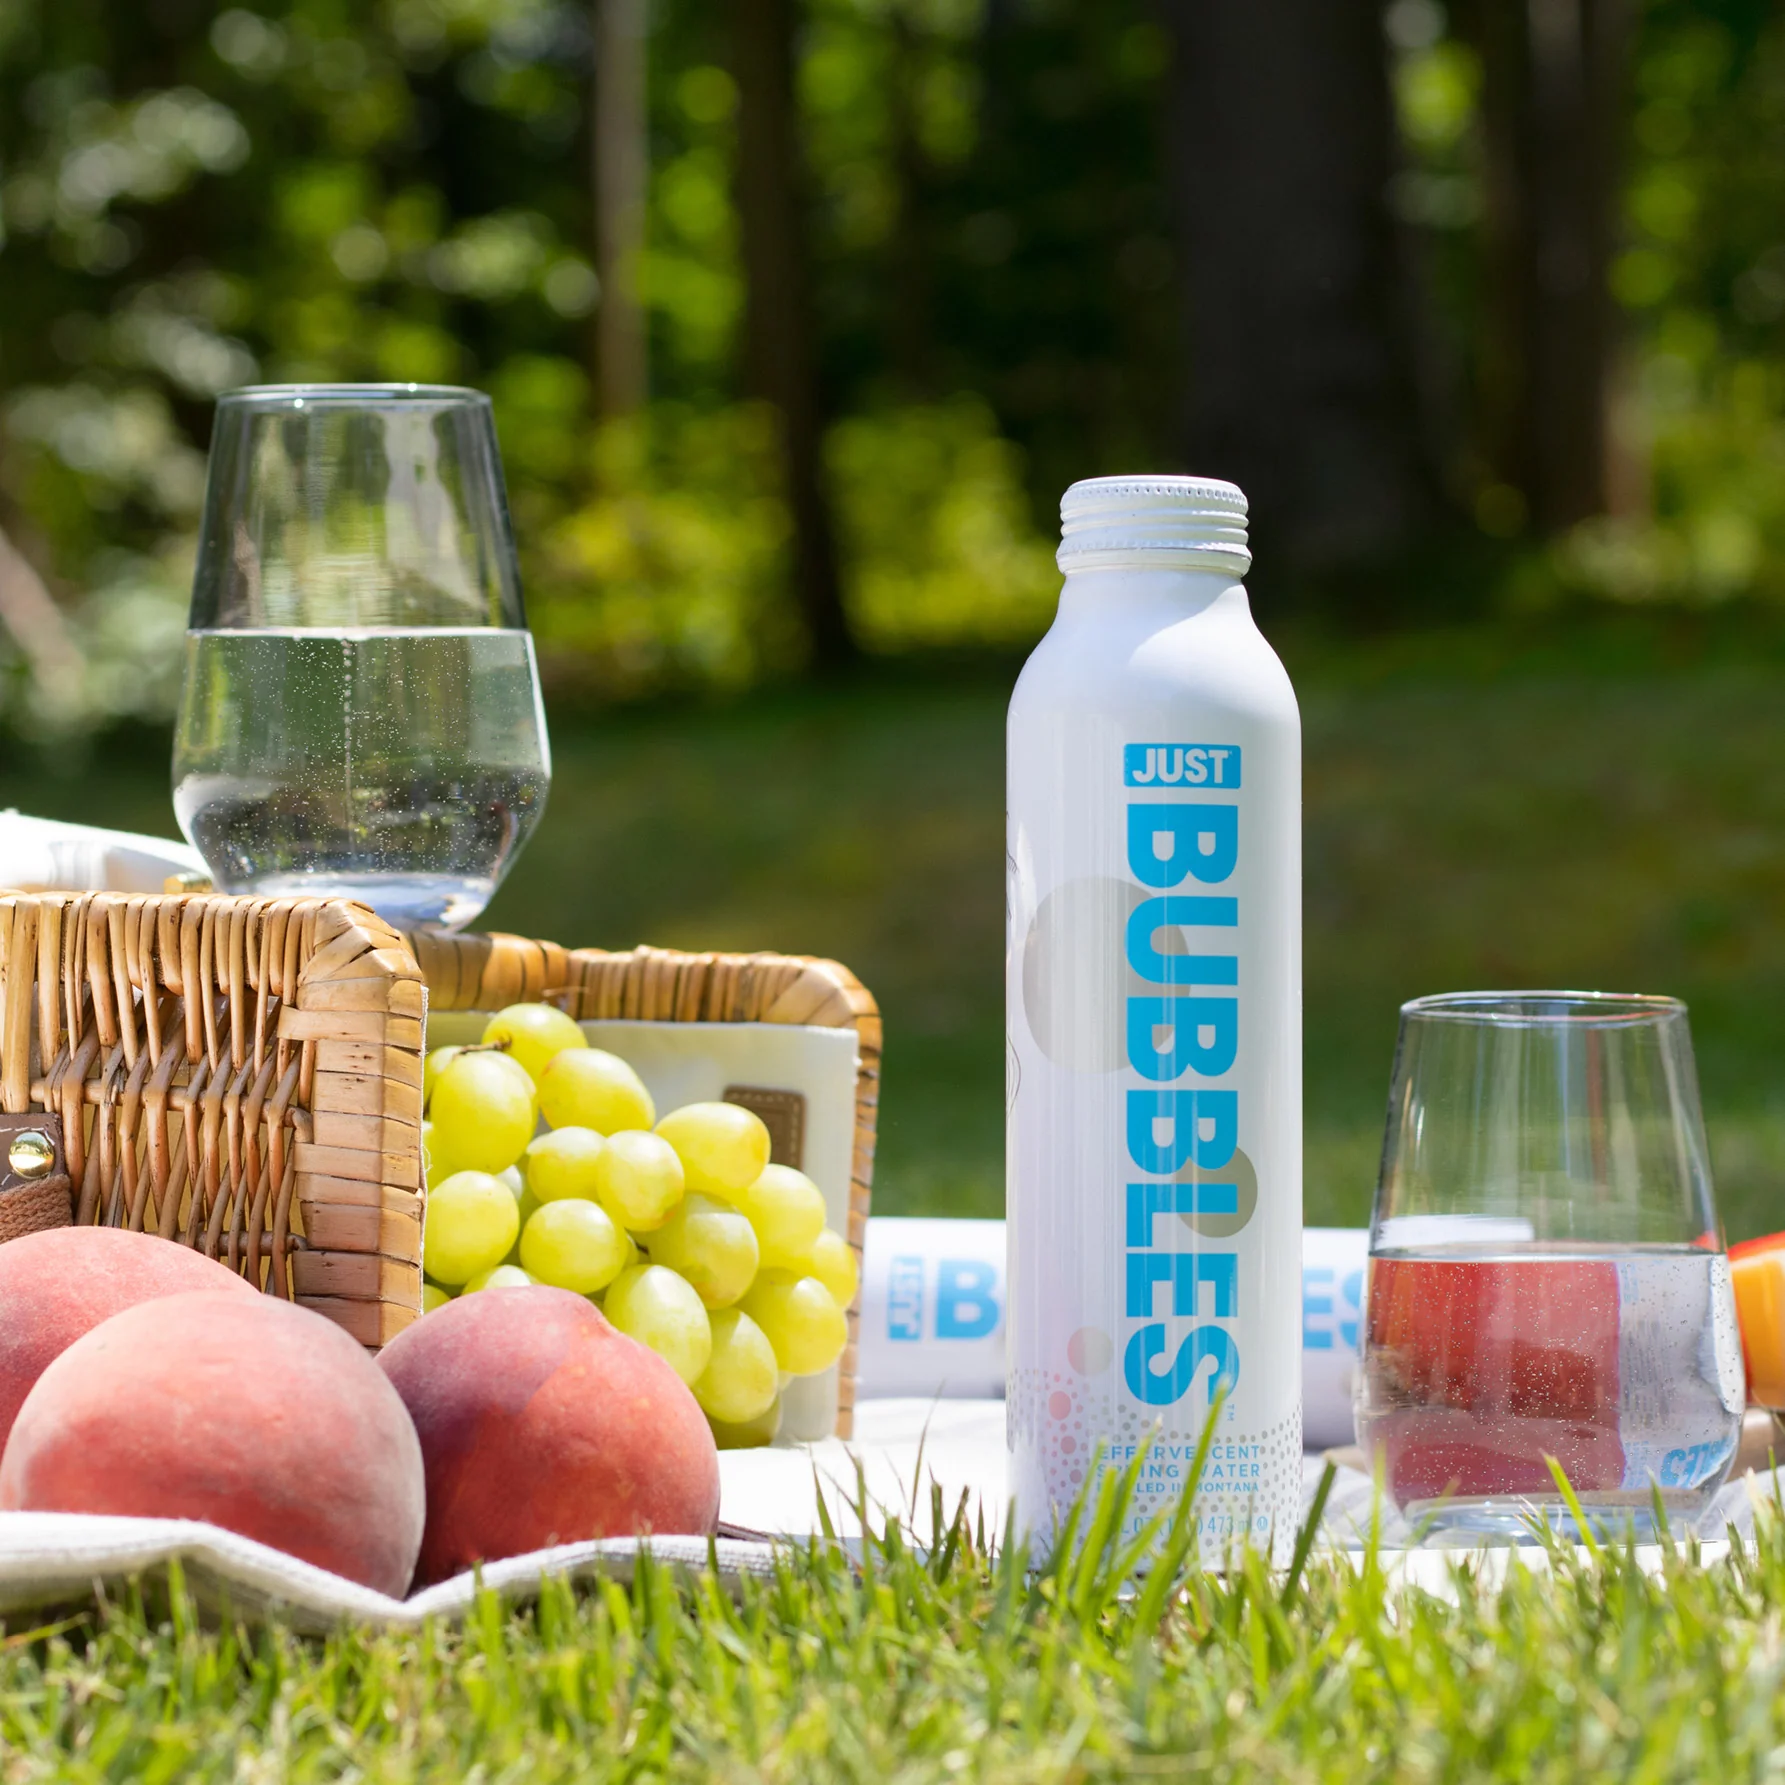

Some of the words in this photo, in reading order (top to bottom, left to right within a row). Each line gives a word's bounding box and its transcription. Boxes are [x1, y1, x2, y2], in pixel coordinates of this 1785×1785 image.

[1131, 747, 1231, 785] JUST
[1123, 803, 1240, 1406] BUBBLES
[1098, 1445, 1260, 1460] EFFRVECENT
